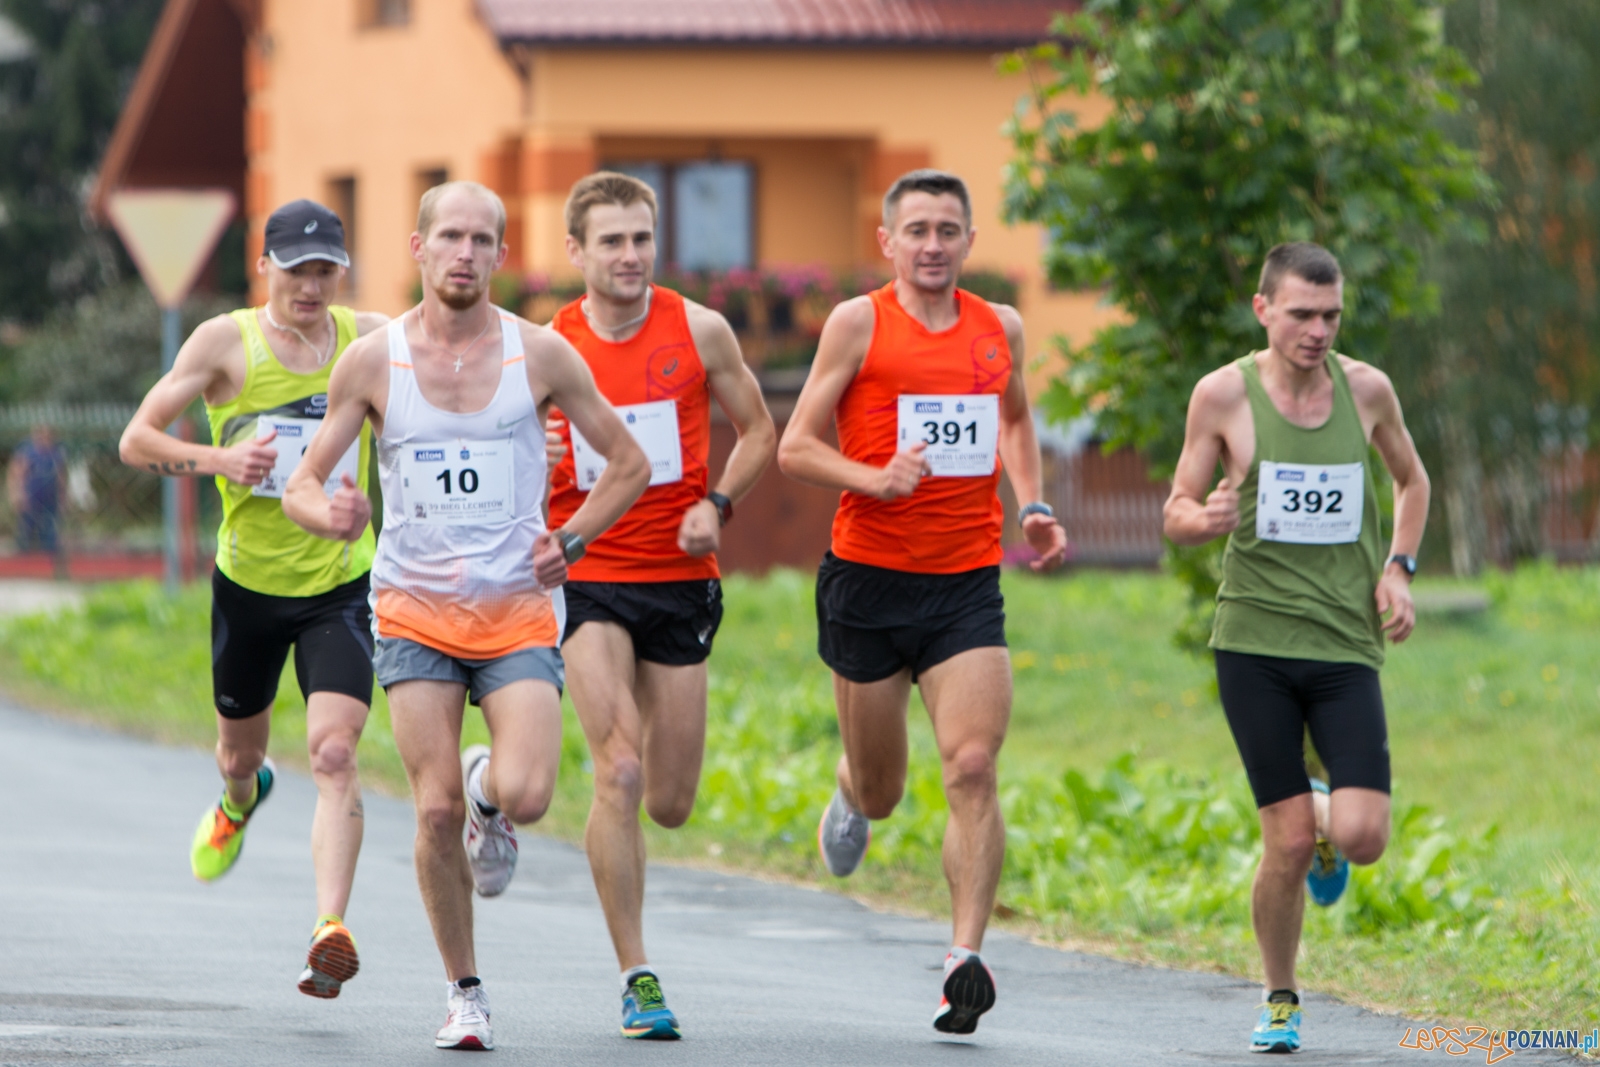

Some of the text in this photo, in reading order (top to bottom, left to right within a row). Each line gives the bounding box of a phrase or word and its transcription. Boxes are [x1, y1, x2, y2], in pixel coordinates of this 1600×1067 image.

[922, 421, 976, 445] 391
[436, 468, 479, 494] 10
[440, 502, 461, 510] BIEG
[1282, 488, 1343, 513] 392
